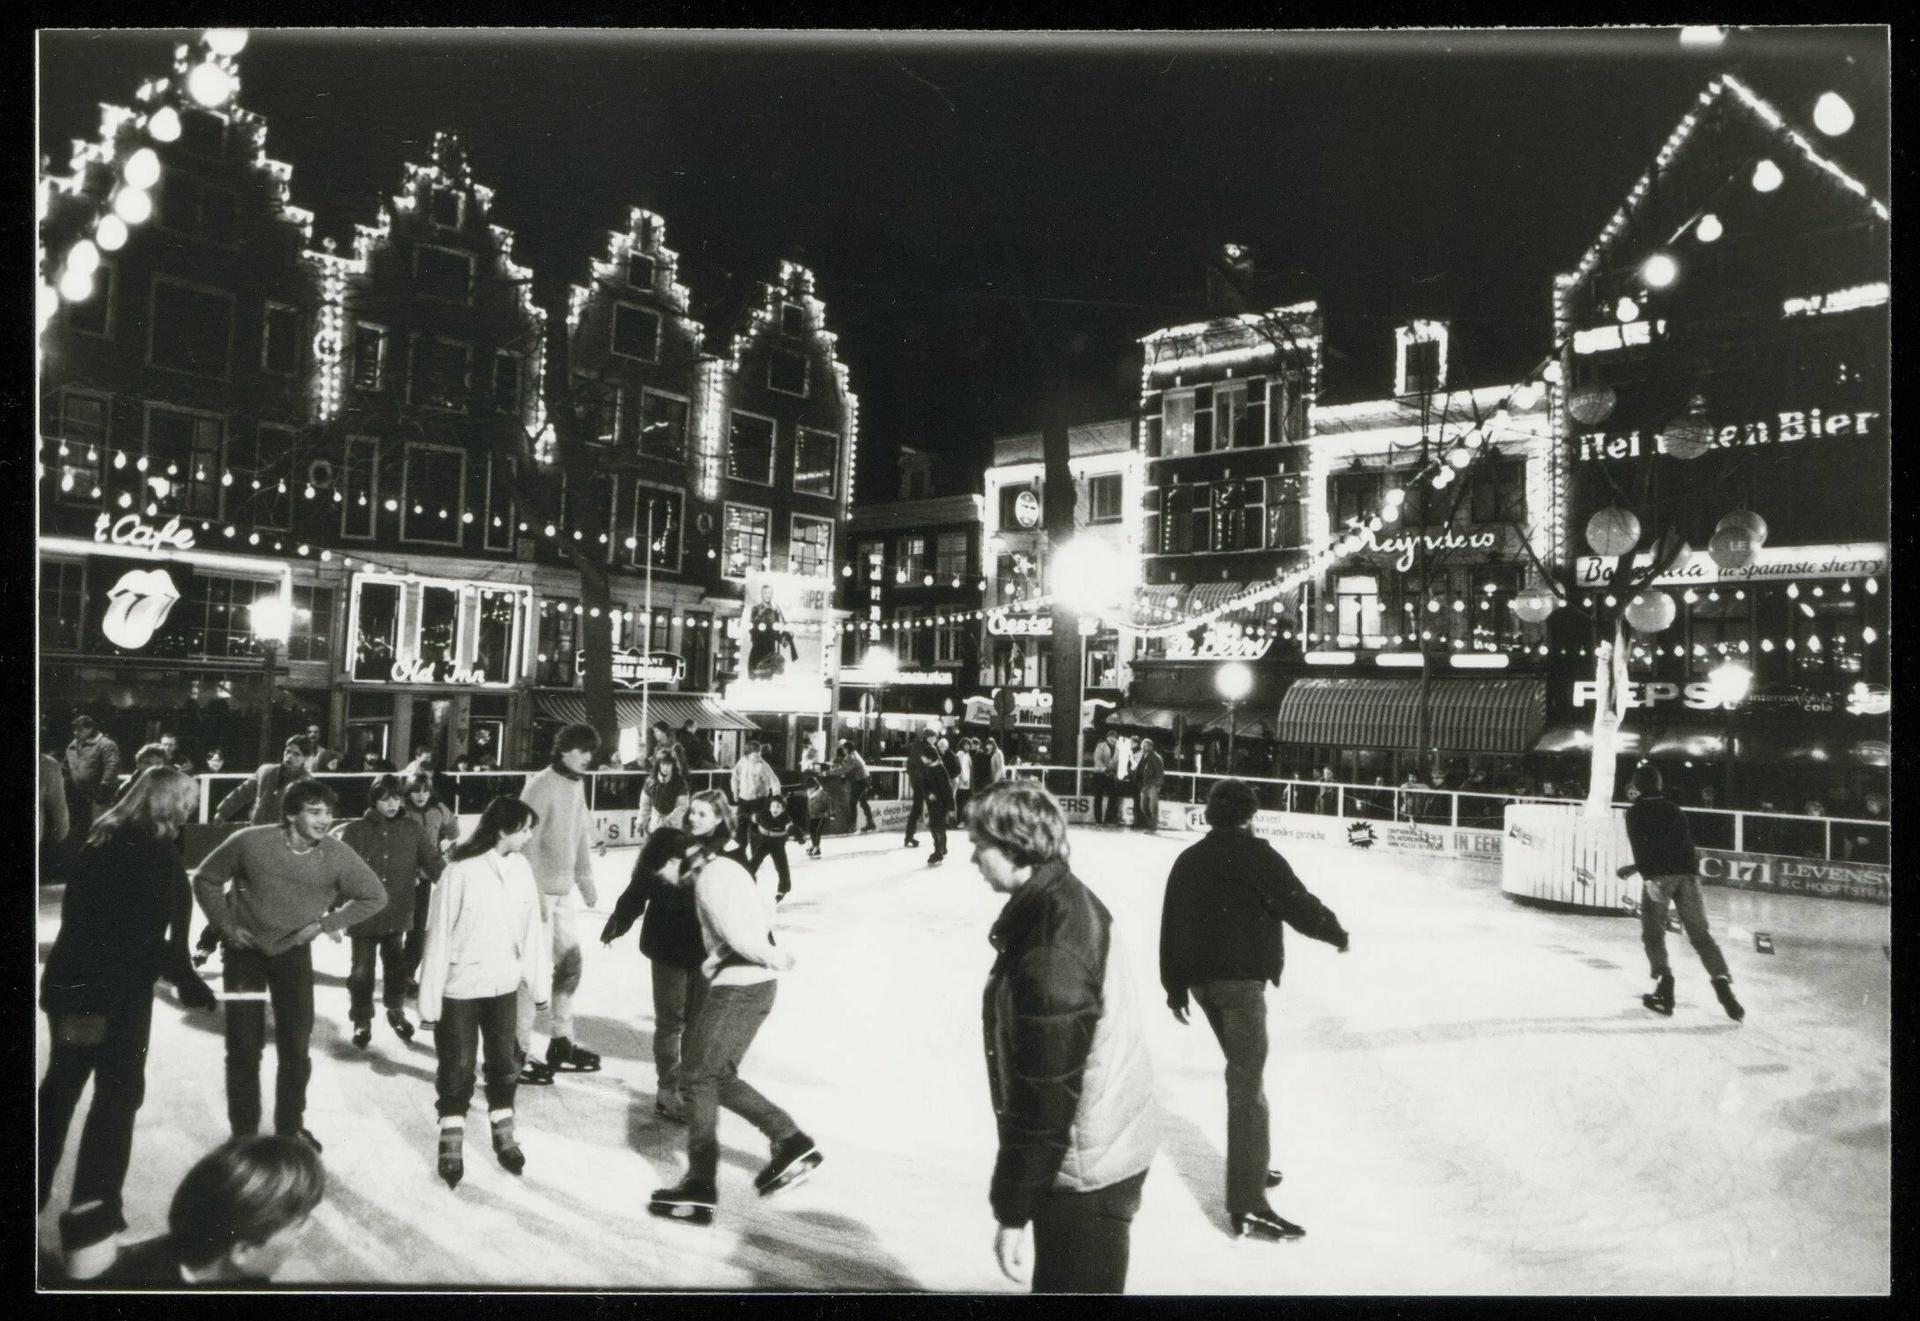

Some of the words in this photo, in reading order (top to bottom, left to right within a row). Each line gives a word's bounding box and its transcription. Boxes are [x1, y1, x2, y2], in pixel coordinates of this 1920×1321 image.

[1579, 421, 1769, 462] Heien
[1778, 408, 1879, 443] Bier
[1819, 555, 1884, 577] sherry
[391, 658, 435, 683] Old
[444, 660, 485, 684] Inn
[1573, 681, 1737, 710] PEPS
[1804, 702, 1833, 712] cola
[1019, 708, 1052, 725] Mireill
